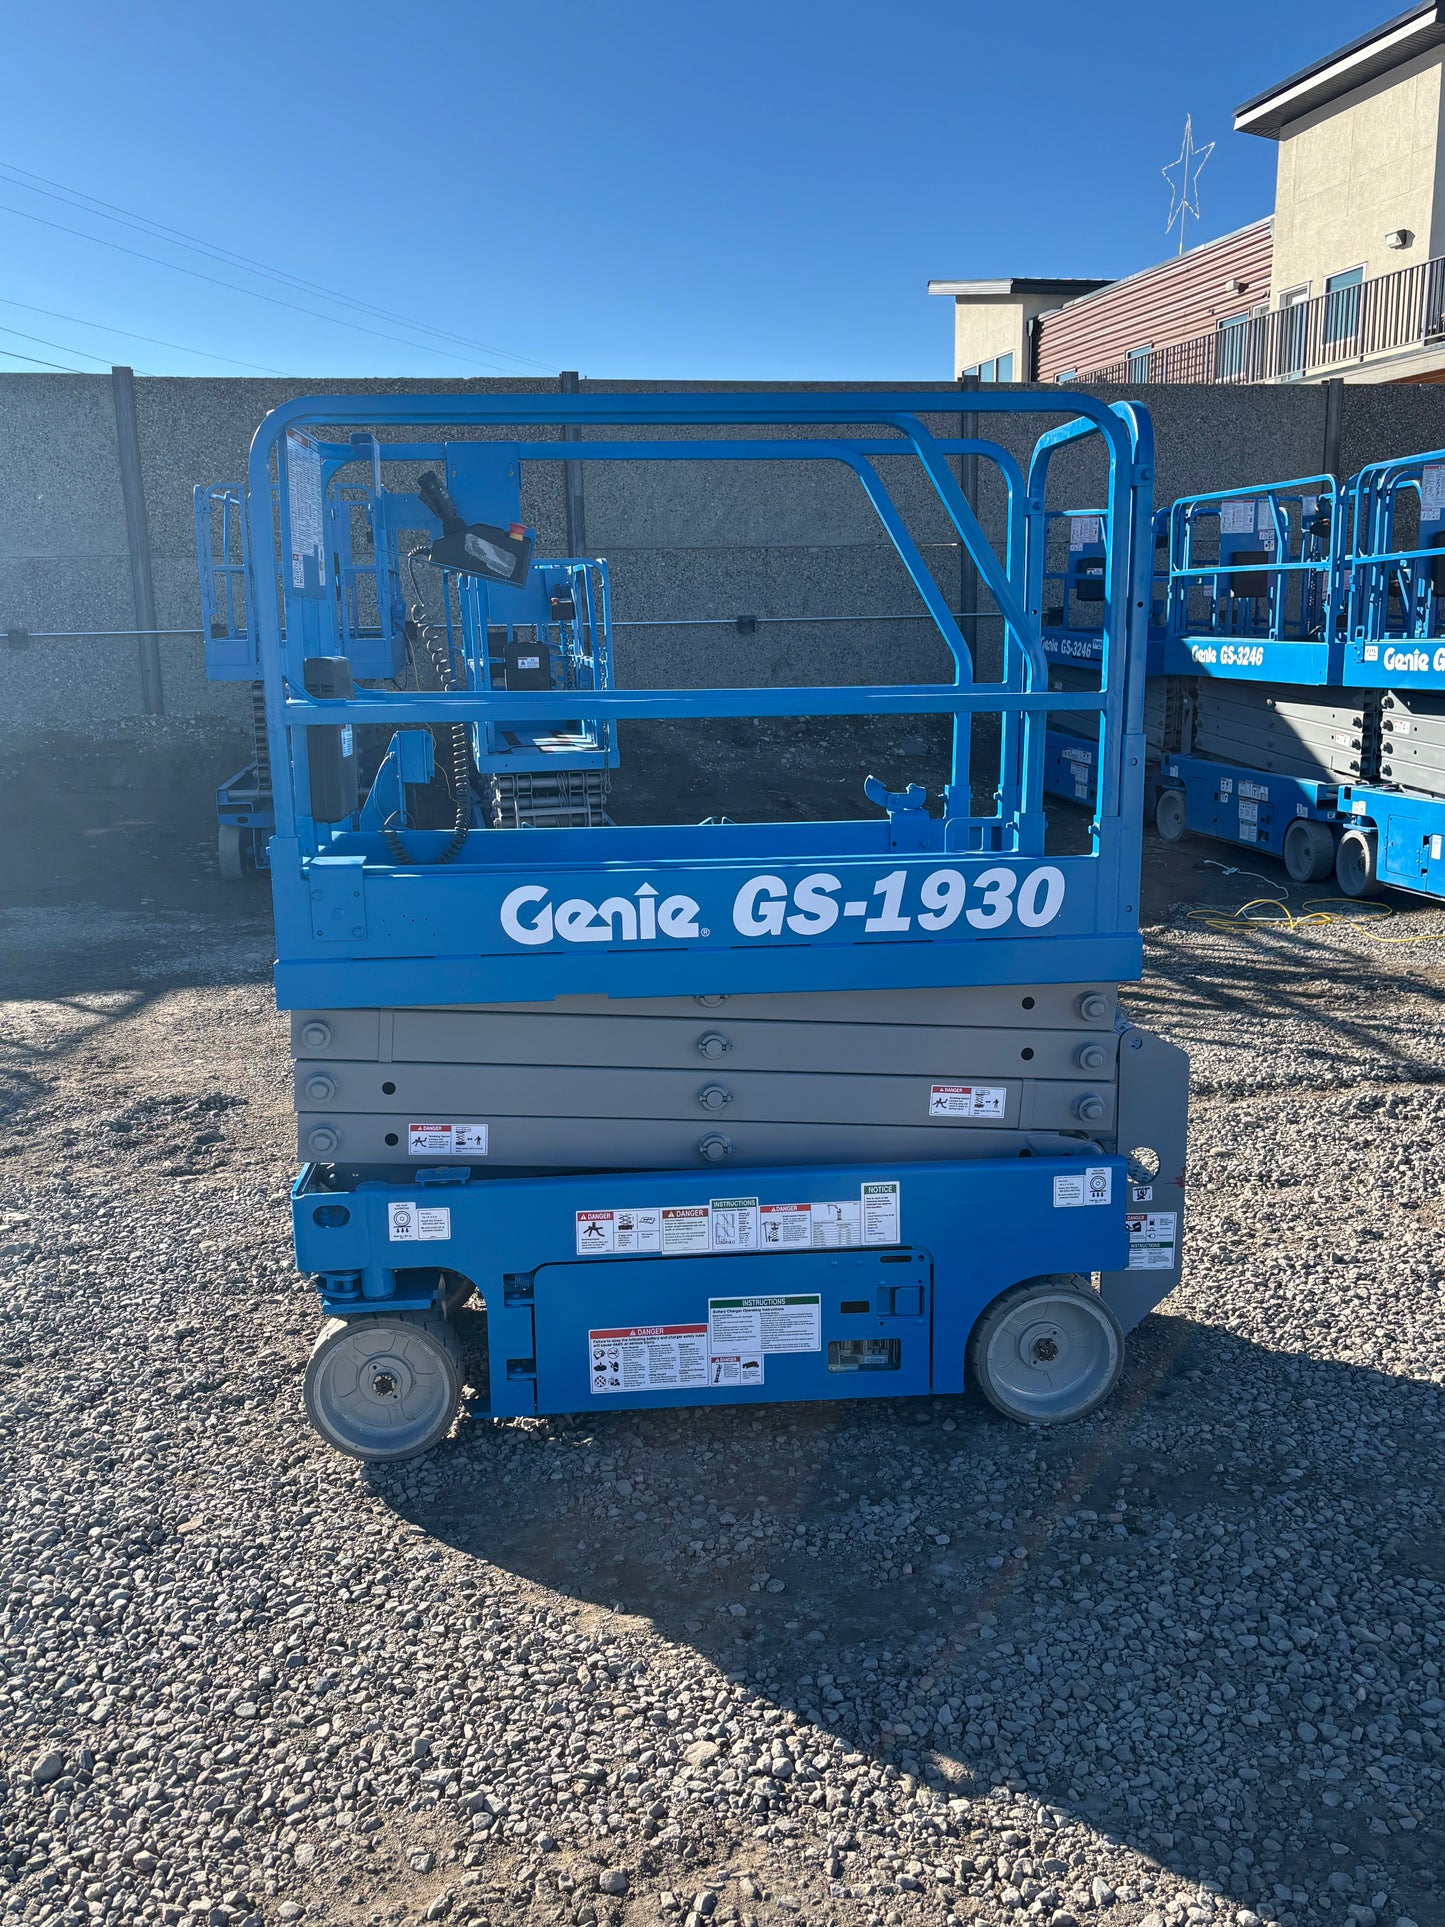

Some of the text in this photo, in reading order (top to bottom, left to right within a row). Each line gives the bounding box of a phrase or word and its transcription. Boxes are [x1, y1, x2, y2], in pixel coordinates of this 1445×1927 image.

[1061, 639, 1092, 658] GS-3246
[1191, 645, 1264, 666] Genie GS-3246
[1384, 647, 1430, 672] Genie
[500, 866, 1066, 946] Genie GS-1930
[713, 1199, 756, 1208] INSTRUCTIONS
[676, 1209, 704, 1218] DANGER
[742, 1298, 786, 1307] INSTRUCTIONS
[637, 1328, 664, 1336] DANGER
